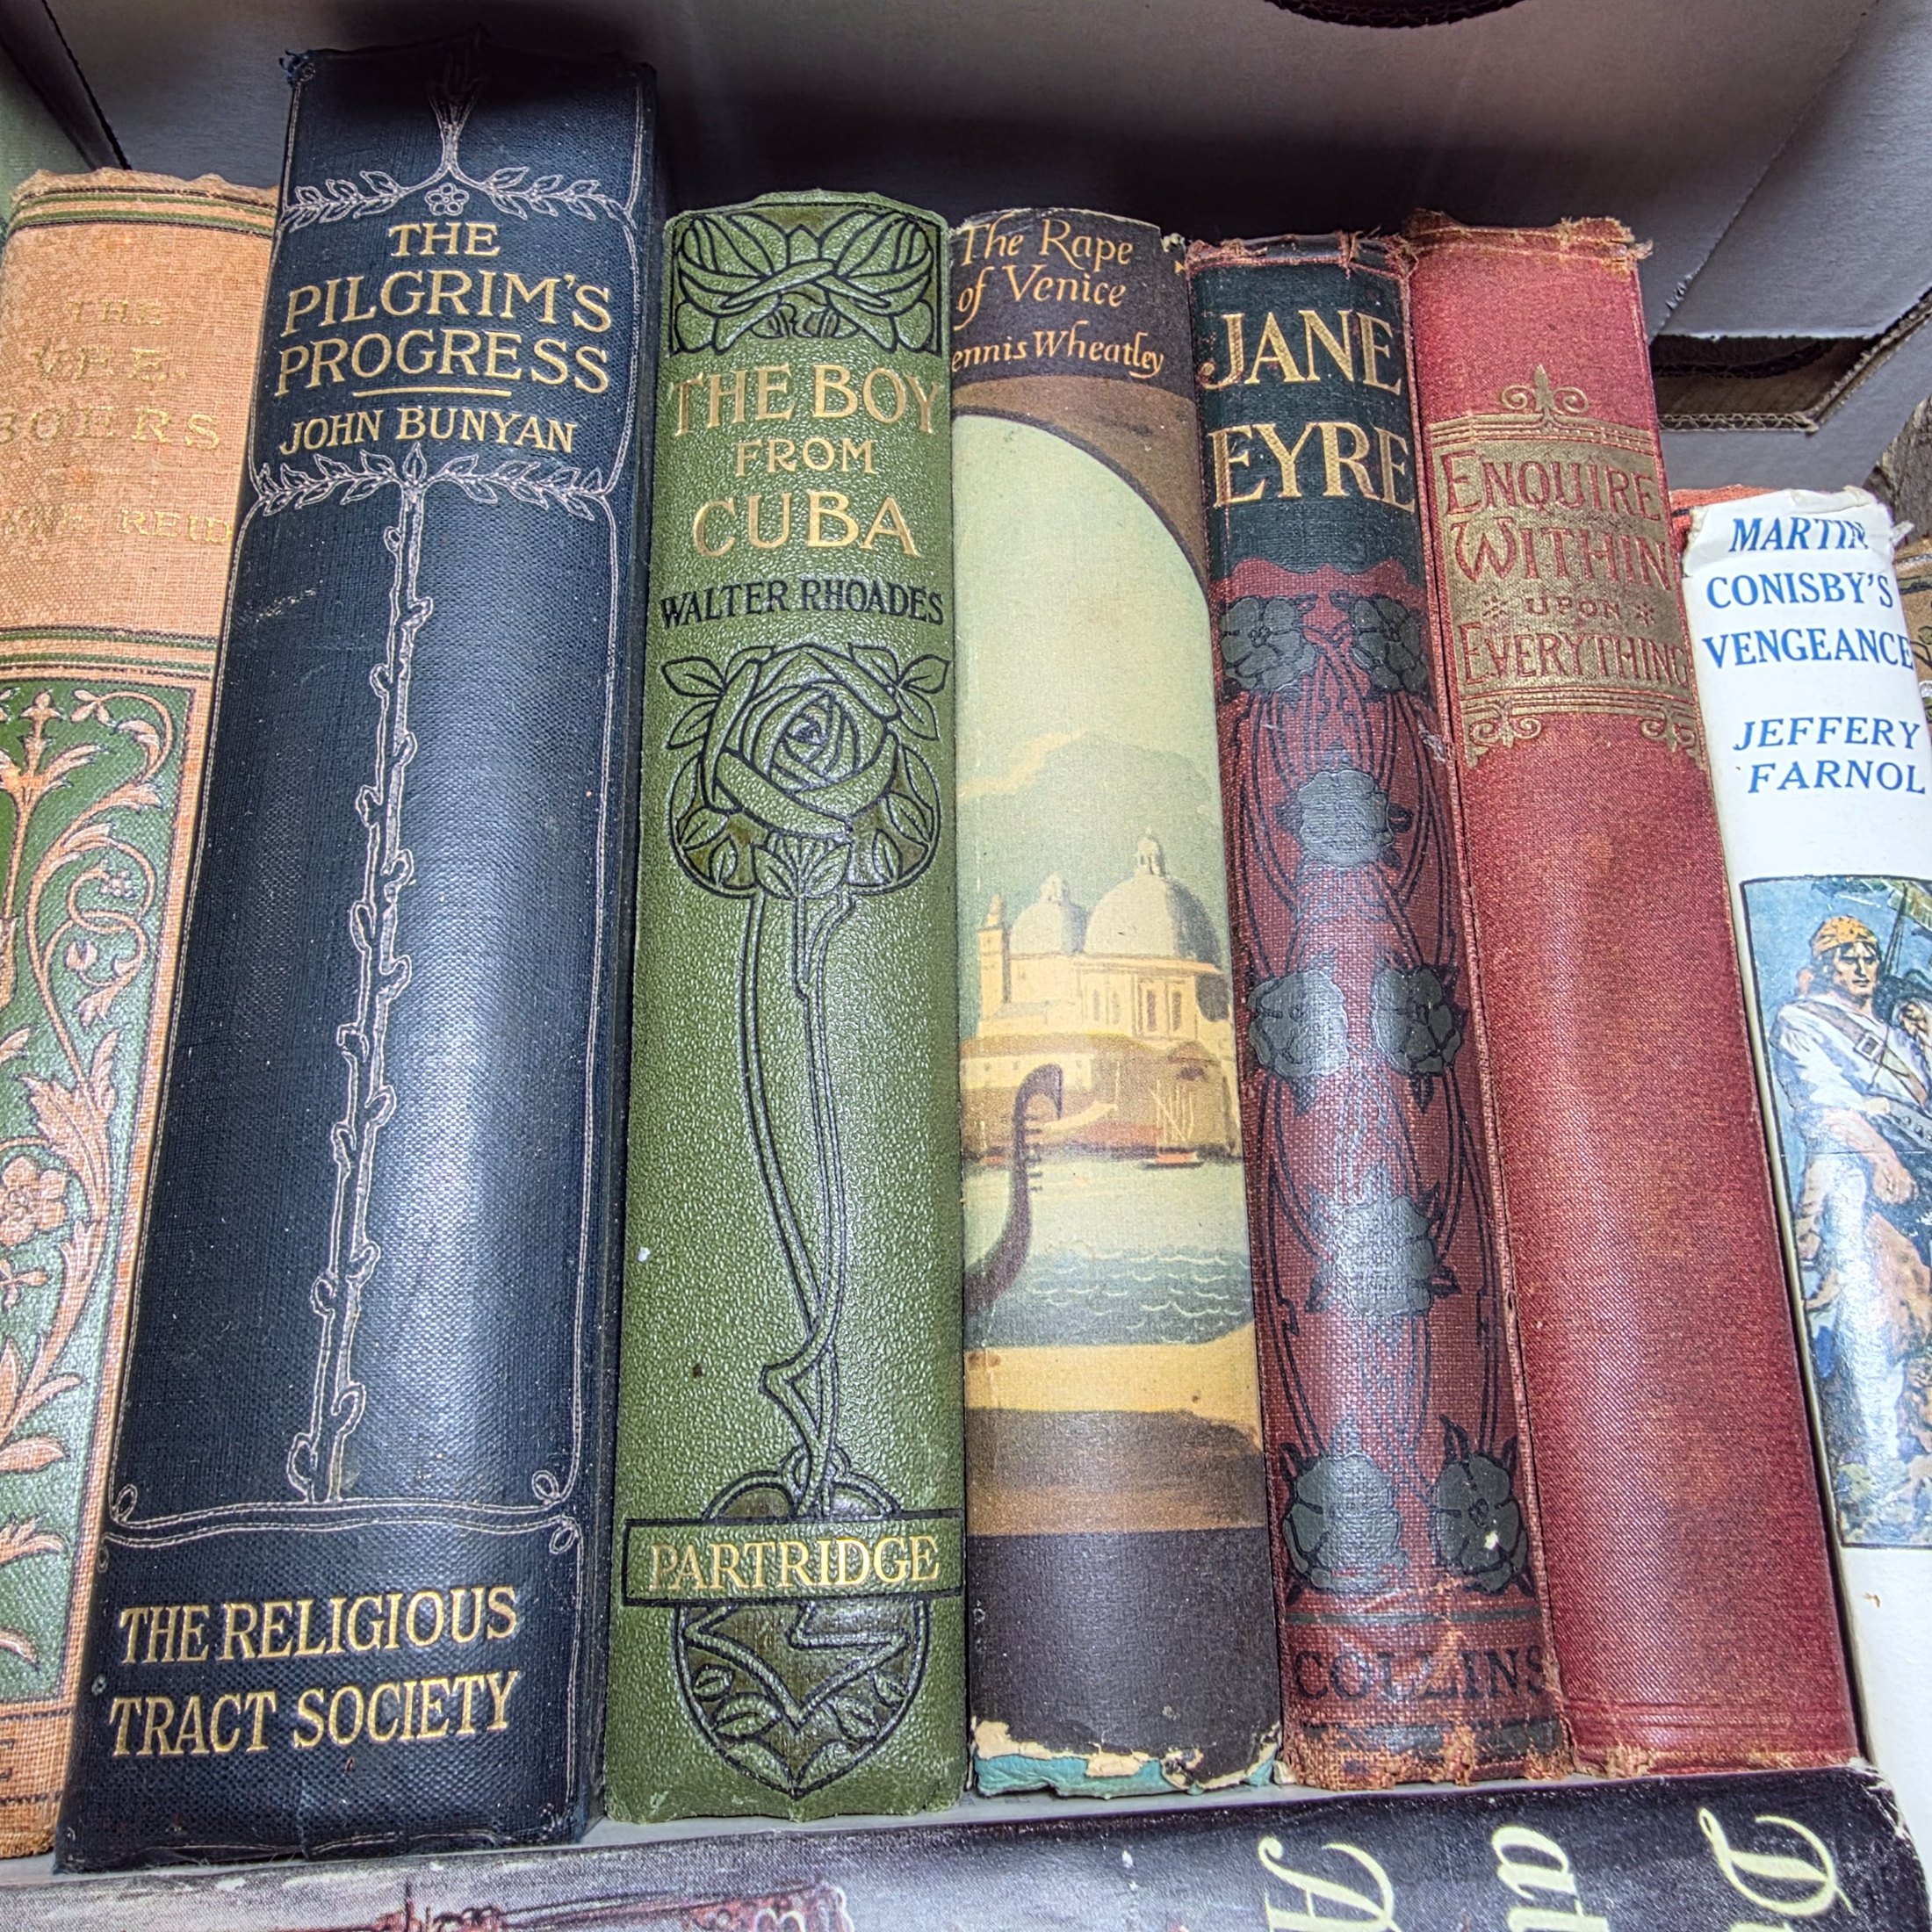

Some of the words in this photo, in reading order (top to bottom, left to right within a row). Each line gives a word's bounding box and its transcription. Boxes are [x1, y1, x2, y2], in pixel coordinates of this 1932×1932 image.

[388, 222, 501, 256] THE
[962, 213, 1024, 266] The
[1039, 219, 1133, 272] Rape
[279, 270, 612, 337] PILGRIM'S
[953, 265, 995, 331] of
[1002, 264, 1126, 307] Venice
[275, 328, 609, 397] PROGRESS
[951, 335, 1027, 372] ennis
[1034, 320, 1164, 378] Wheatley
[1197, 309, 1402, 395] JANE
[673, 364, 795, 437] THE
[812, 363, 944, 434] BOY
[279, 408, 381, 456] JOHN
[395, 405, 577, 453] BUNYAN
[736, 438, 877, 477] FROM
[1208, 421, 1415, 513] EYRE
[1441, 449, 1661, 521] ENQUIRE
[693, 489, 919, 557] CUBA
[1728, 516, 1869, 552] MARTIN
[1451, 516, 1670, 591] WITHIN
[660, 579, 789, 630] WALTER
[799, 576, 944, 624] RHOADES
[1525, 596, 1621, 617] UPON
[1705, 571, 1893, 609] CONISBY'S
[1459, 622, 1690, 687] EVERYTHING
[1702, 628, 1914, 671] VENGEANCE
[1733, 717, 1920, 751] JEFFERY
[1747, 760, 1926, 794] FARNOL
[651, 1534, 940, 1593] PARTRIDGE
[119, 1604, 210, 1665] THE
[222, 1585, 518, 1662] RELIGIOUS
[1294, 1644, 1550, 1702] COLLINS
[109, 1690, 276, 1756] TRACT
[293, 1669, 522, 1749] SOCIETY
